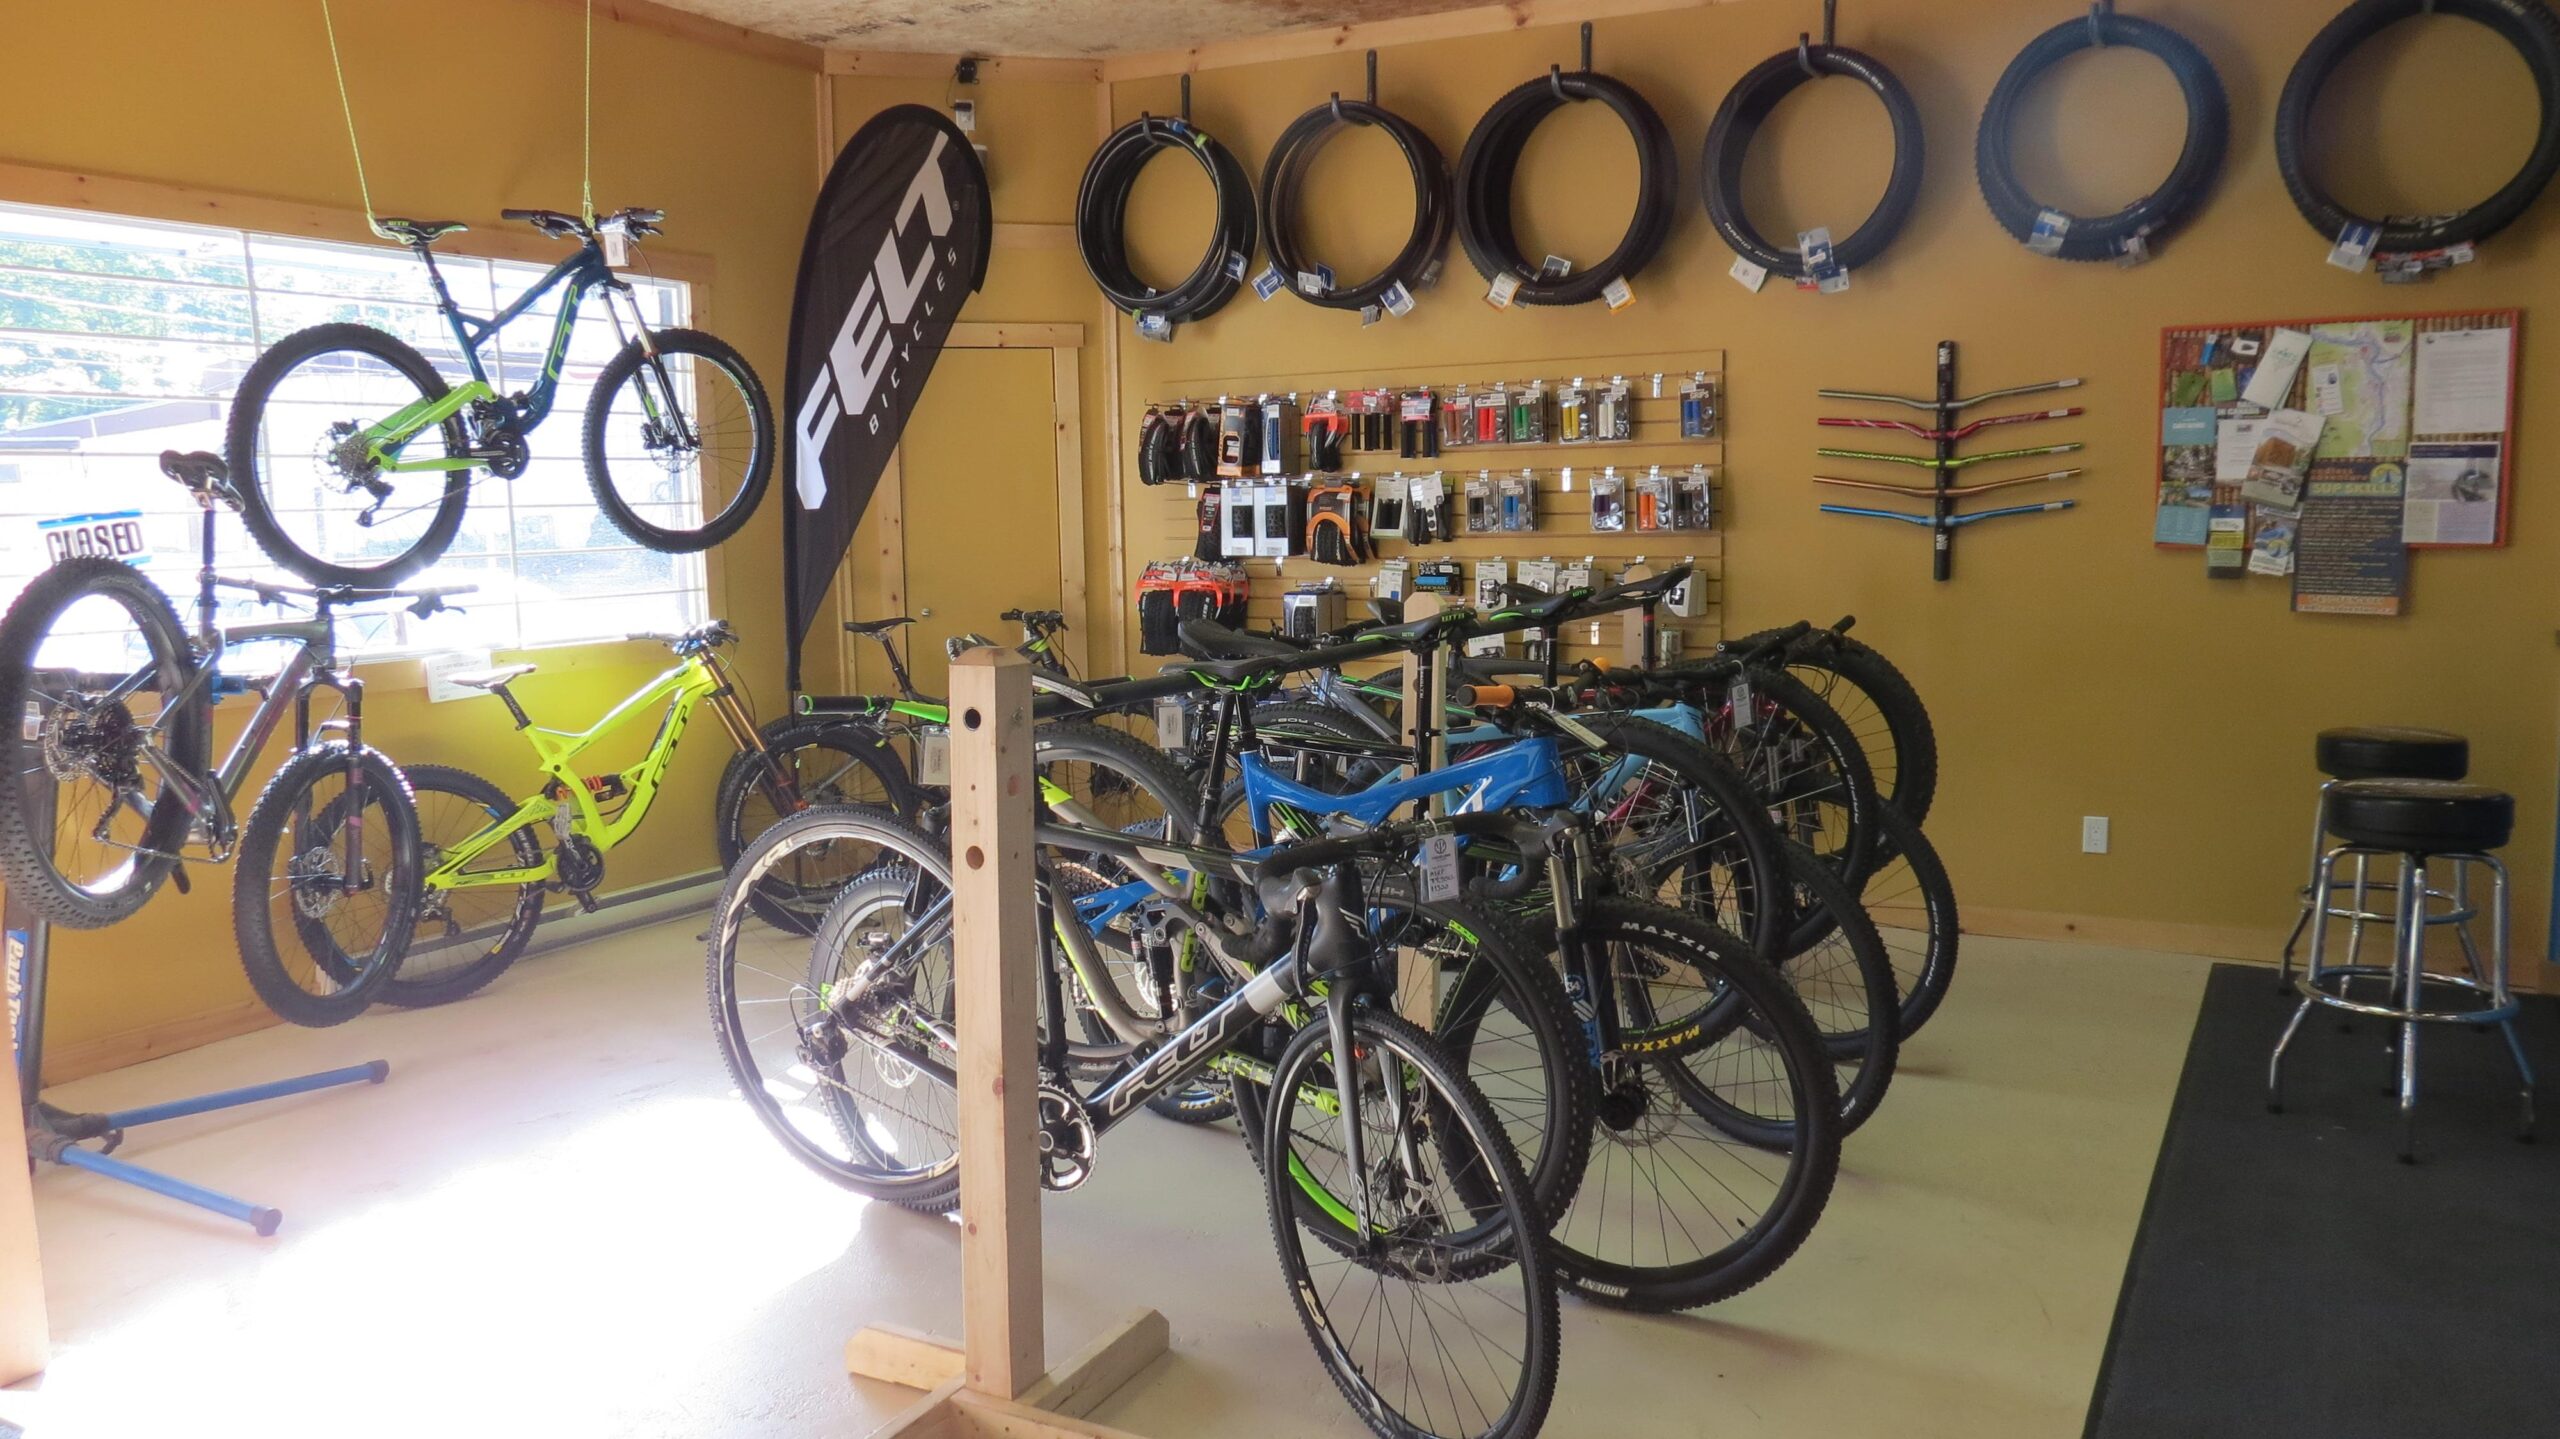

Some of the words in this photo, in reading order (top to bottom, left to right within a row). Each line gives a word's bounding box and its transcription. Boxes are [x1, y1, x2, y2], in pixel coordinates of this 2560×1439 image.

[797, 130, 953, 510] FELT
[868, 247, 957, 435] BICYCLES
[6, 936, 25, 995] Park
[1621, 921, 1721, 961] MAXXIS
[1109, 994, 1238, 1117] FELT
[1575, 1276, 1630, 1299] ARDENT
